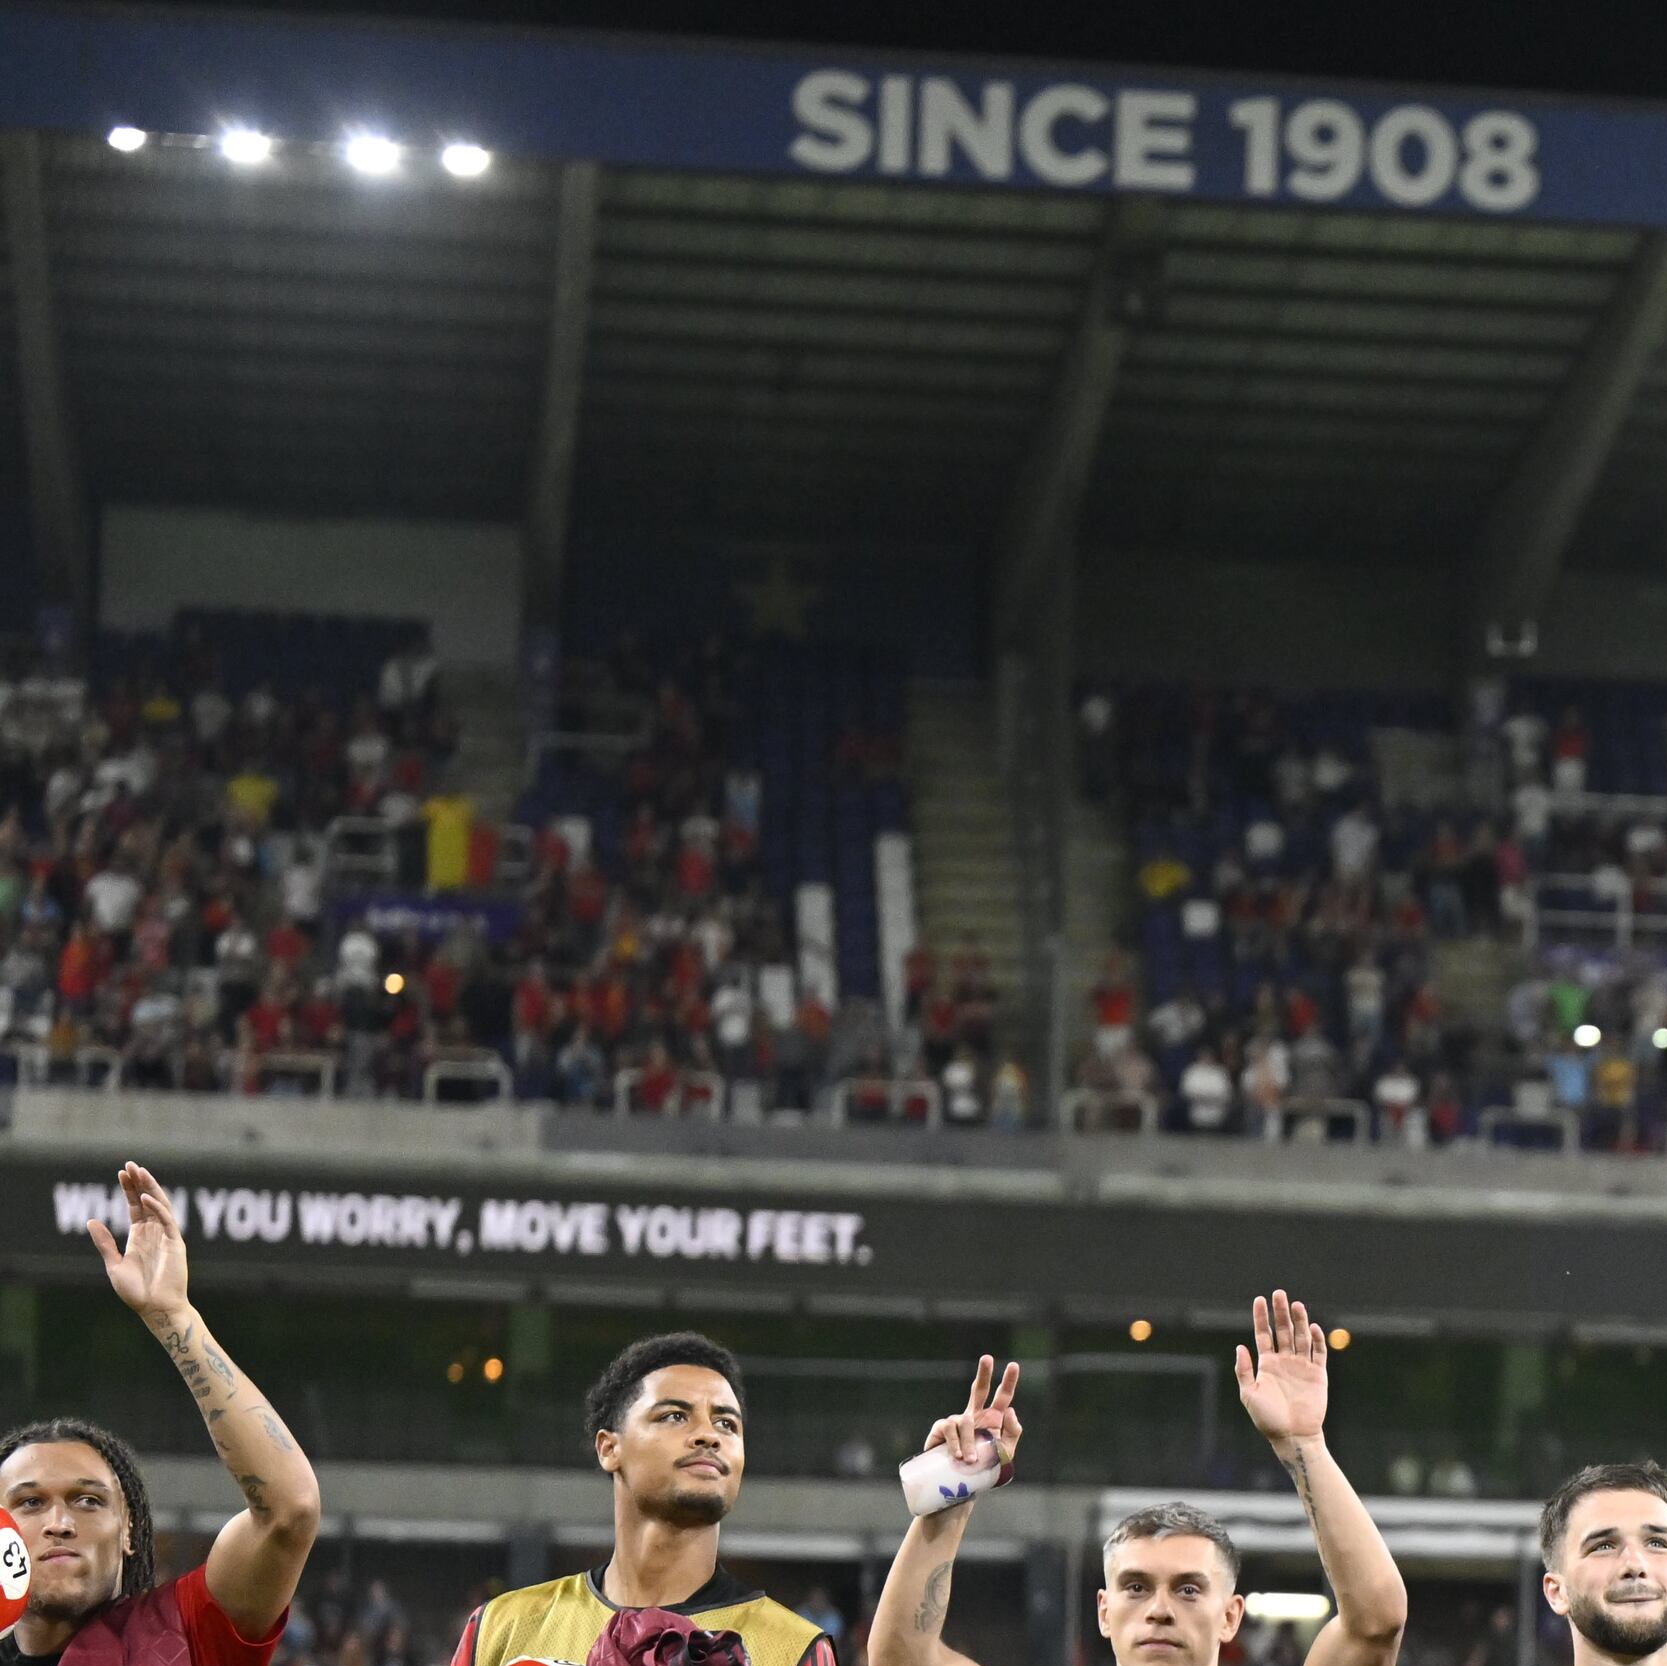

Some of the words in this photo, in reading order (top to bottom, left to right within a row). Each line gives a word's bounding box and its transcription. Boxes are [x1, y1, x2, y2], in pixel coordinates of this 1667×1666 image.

[790, 70, 1195, 191] SINCE
[1229, 96, 1539, 211] 1908
[196, 1188, 291, 1243] YOU
[300, 1191, 472, 1256] WORRY,
[480, 1199, 608, 1255] MOVE
[616, 1205, 742, 1261] YOUR
[747, 1210, 873, 1266] FEET.
